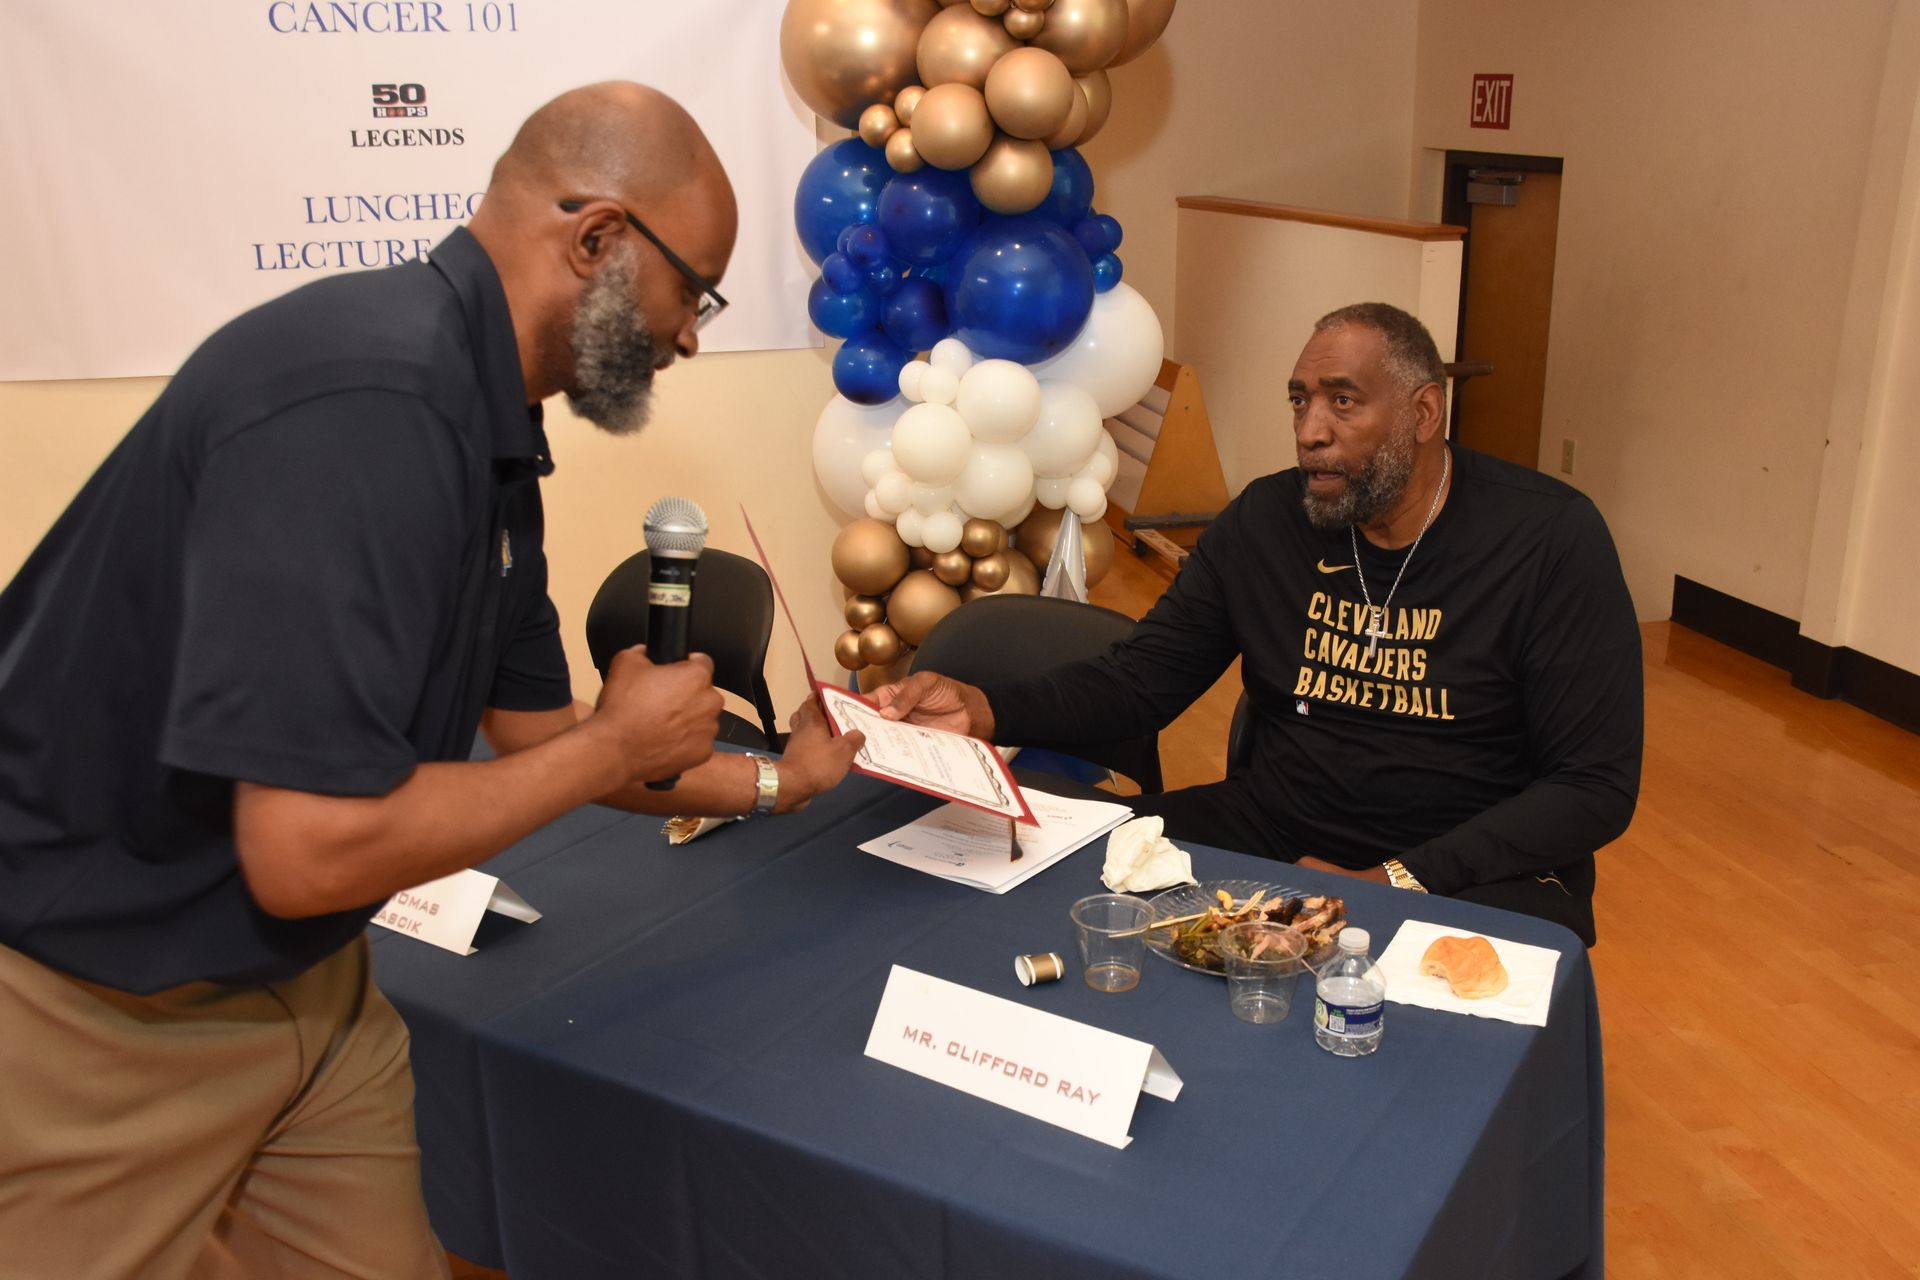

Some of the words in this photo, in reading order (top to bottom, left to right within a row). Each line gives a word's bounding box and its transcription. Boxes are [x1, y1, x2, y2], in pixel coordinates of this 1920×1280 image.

[267, 1, 451, 34] CANCER
[465, 2, 520, 32] 101
[372, 83, 427, 105] 50
[1473, 80, 1511, 123] EXIT
[350, 128, 465, 147] LEGENDS
[302, 192, 488, 224] LUNCHEO
[252, 238, 431, 270] LECTURE
[1307, 592, 1442, 640] CLEVELAND
[1303, 628, 1427, 681] CAVALIERS
[1293, 666, 1455, 720] BASKETBALL
[392, 891, 440, 915] OMAS
[376, 910, 422, 934] ASCIK
[902, 1025, 937, 1050] MR.
[946, 1041, 1048, 1088] CLIFFORD
[1055, 1079, 1101, 1106] RAY
